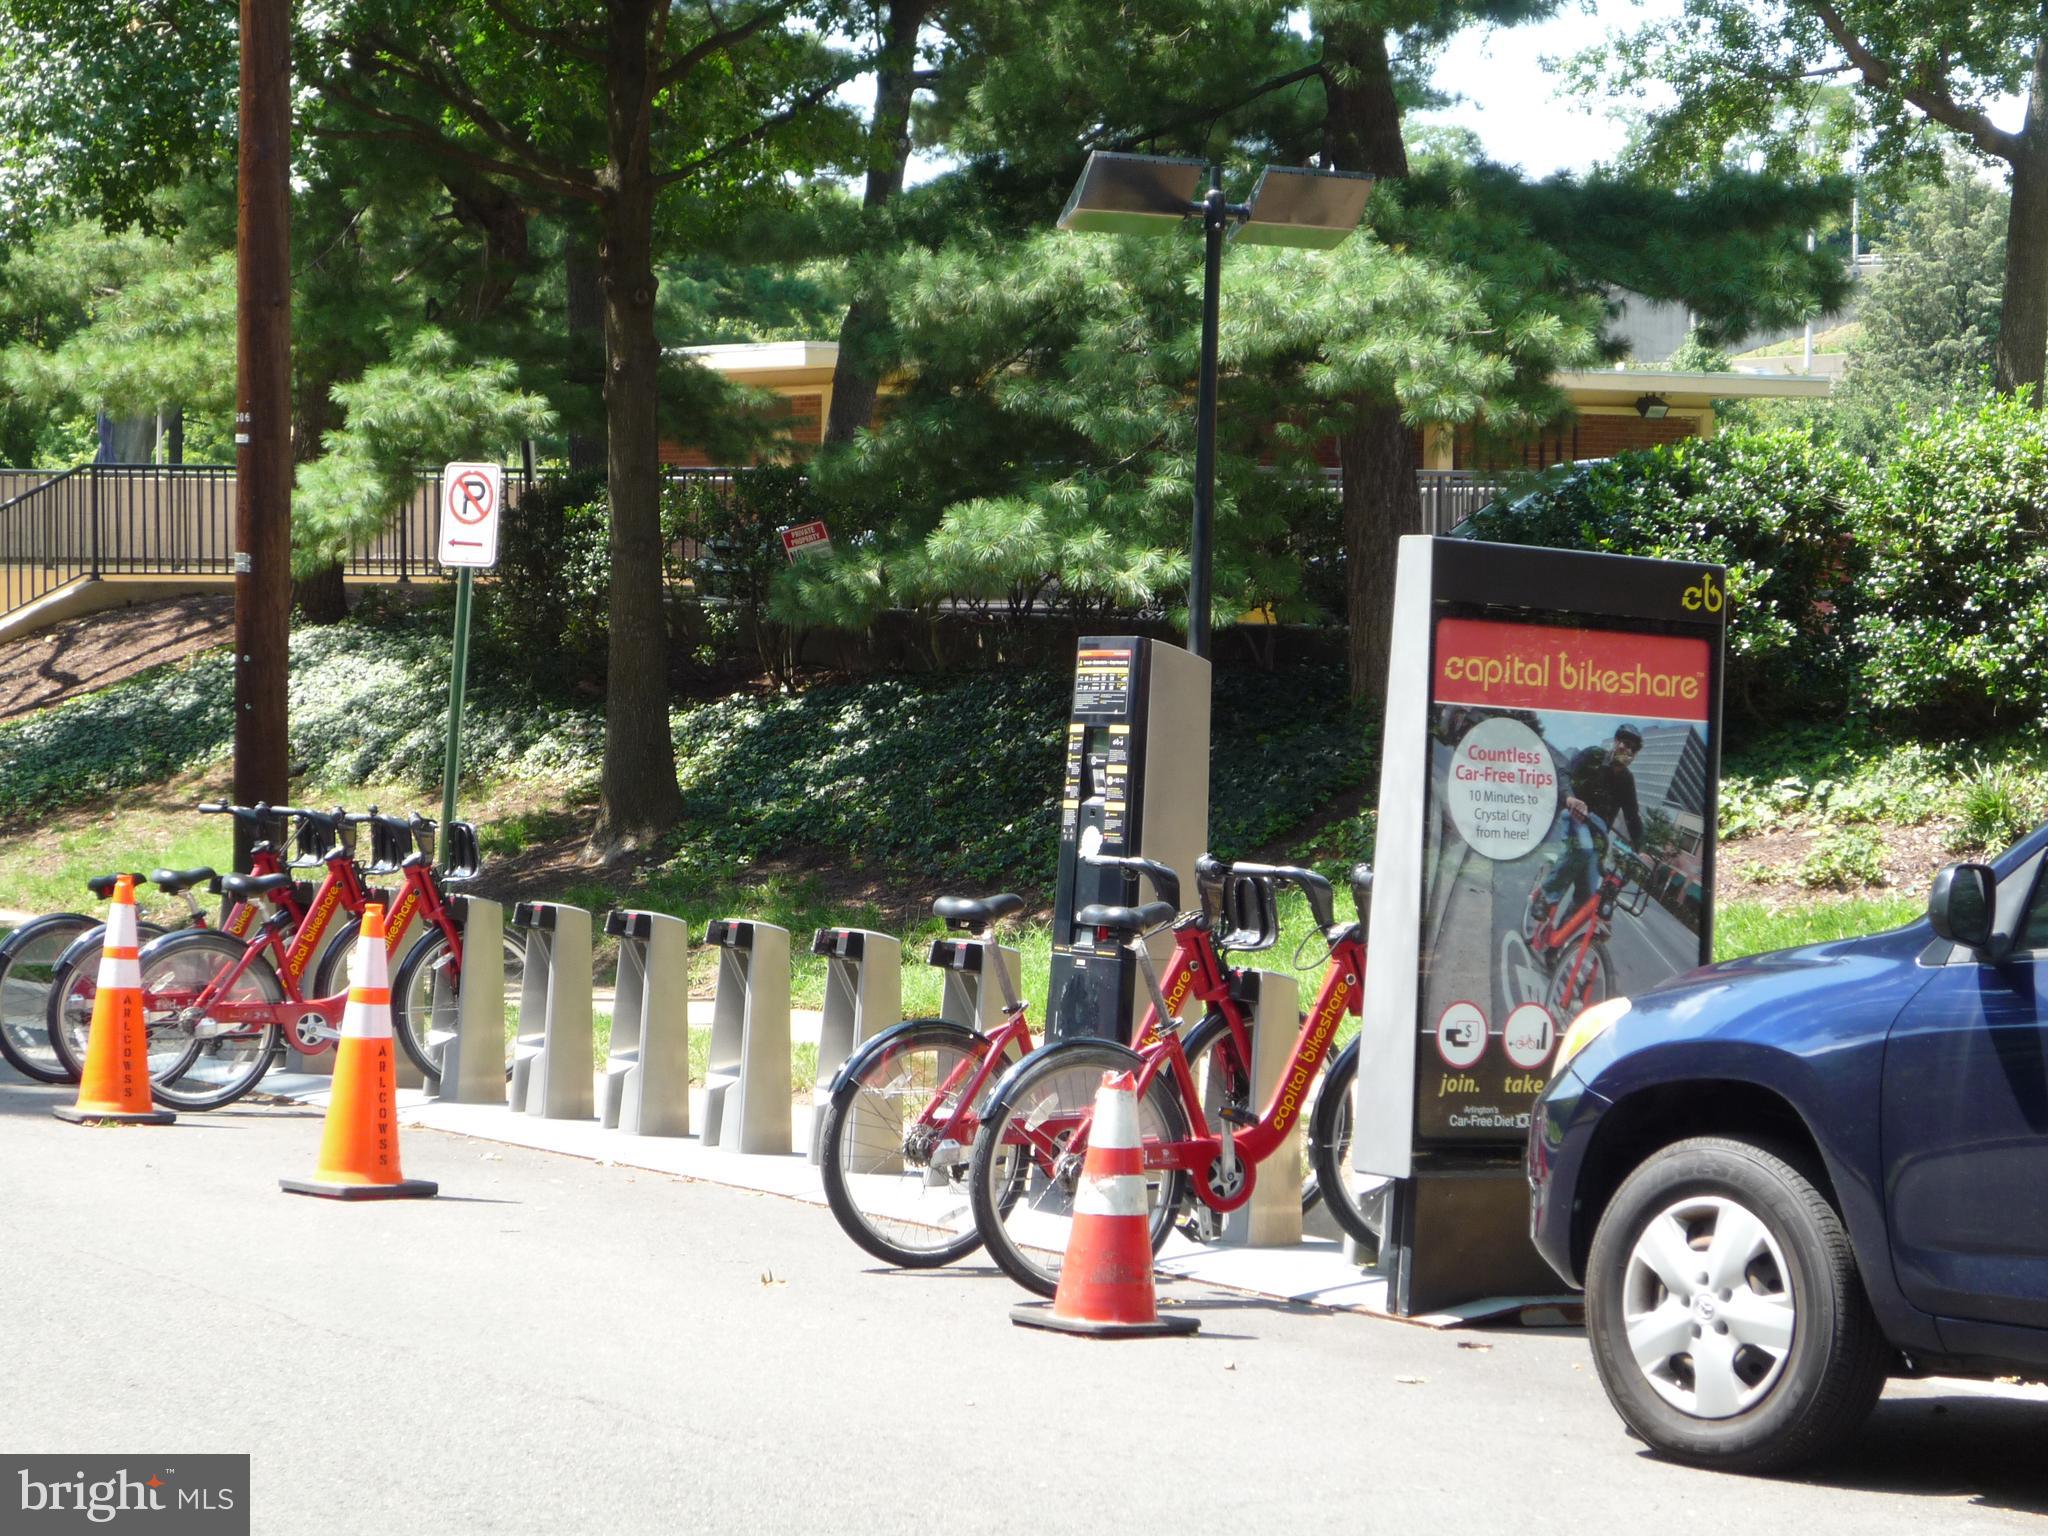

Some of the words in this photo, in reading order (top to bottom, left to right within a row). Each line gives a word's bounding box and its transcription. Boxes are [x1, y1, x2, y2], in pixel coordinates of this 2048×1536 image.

[462, 481, 486, 514] P
[791, 526, 815, 539] PRIVATE
[1444, 655, 1550, 692] capital
[1559, 652, 1699, 700] bikeshare
[1467, 744, 1541, 766] Countless
[1455, 764, 1516, 784] Car-Free
[1518, 769, 1553, 787] Trips
[1469, 790, 1481, 802] 10
[1484, 790, 1525, 805] Minutes
[1528, 794, 1539, 805] to
[1474, 808, 1509, 825] Crystal
[1511, 809, 1532, 827] City
[1476, 826, 1500, 840] from
[1503, 827, 1530, 841] here!
[301, 885, 338, 942] bikeshare
[1273, 1065, 1309, 1131] capital
[1298, 981, 1348, 1063] bikeshare
[1438, 1073, 1480, 1097] join.
[1504, 1074, 1544, 1094] take
[1464, 1105, 1499, 1115] Arlington's
[1449, 1115, 1493, 1128] Car-Free
[1493, 1115, 1514, 1128] Diet
